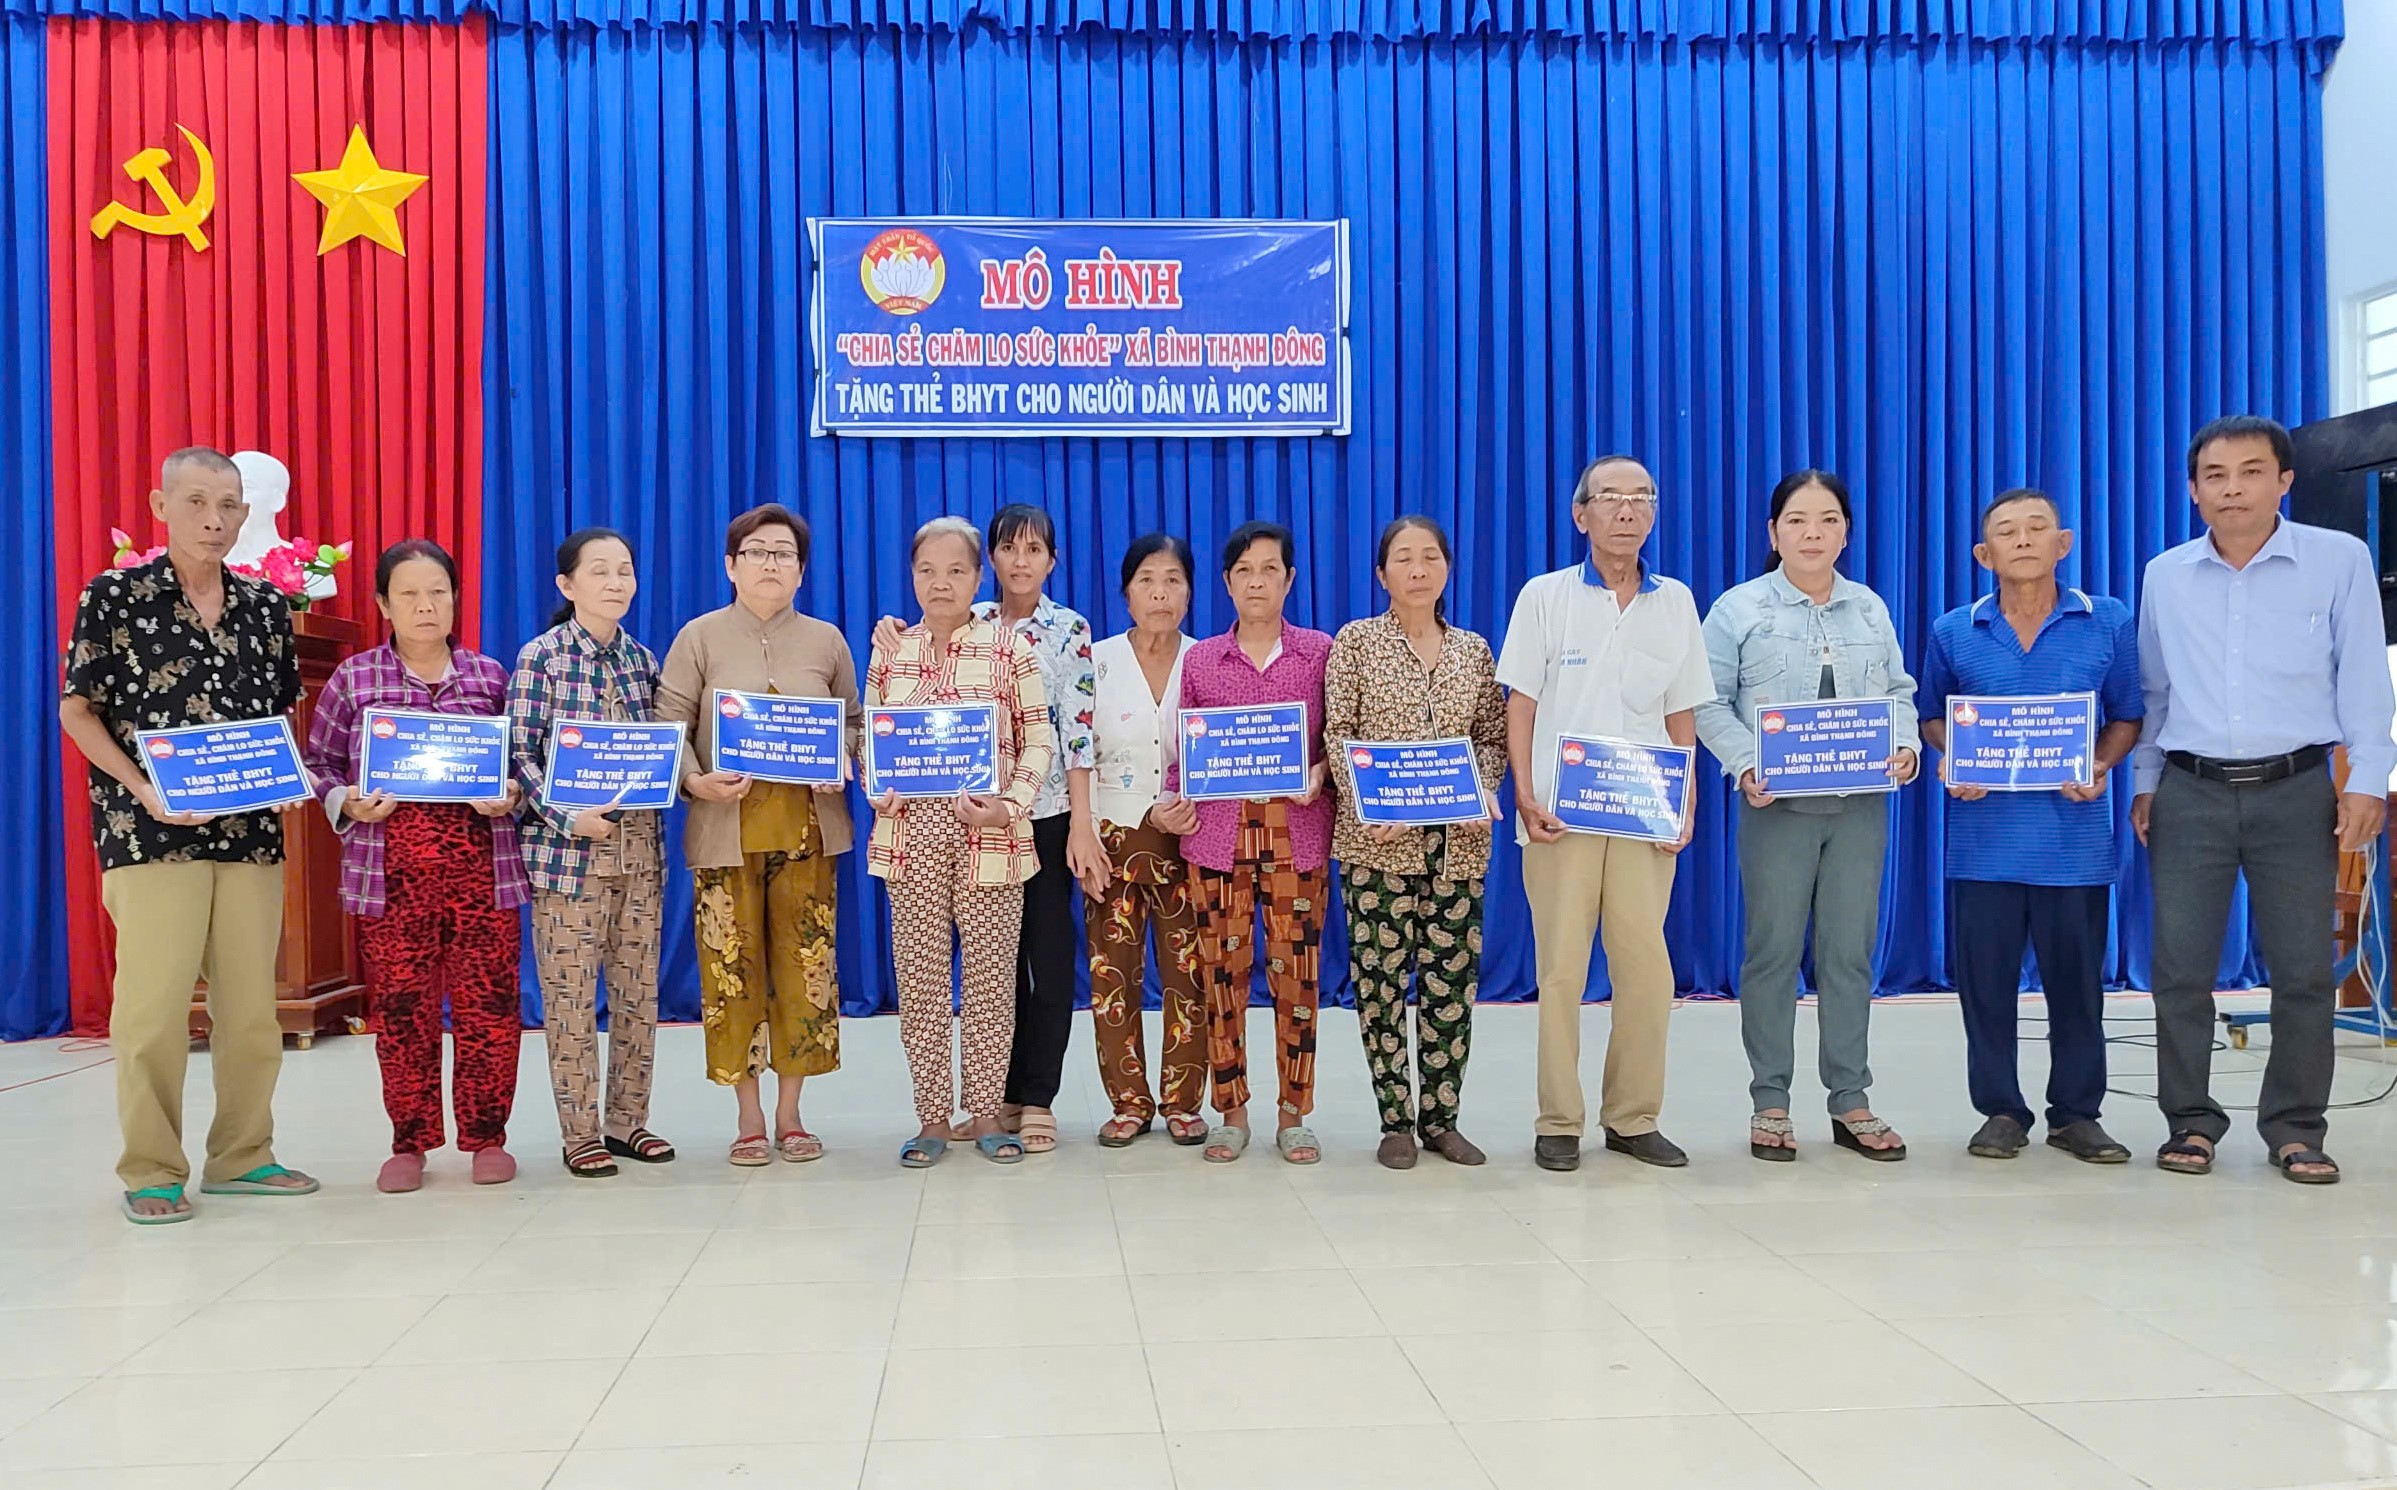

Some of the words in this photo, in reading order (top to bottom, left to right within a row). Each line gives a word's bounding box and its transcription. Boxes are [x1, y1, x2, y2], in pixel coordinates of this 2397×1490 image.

[981, 246, 1052, 310] MÔ
[1065, 246, 1181, 310] HÌNH
[896, 325, 922, 366] SẺ
[927, 327, 981, 366] CHĂM
[987, 335, 1012, 366] LO
[1016, 327, 1056, 367] SỨC
[1124, 327, 1152, 366] XÃ
[1155, 328, 1201, 366] BÌNH
[1206, 335, 1268, 373] THẠNH
[1273, 327, 1326, 367] ĐÔNG
[836, 376, 894, 421] TẶNG
[900, 371, 941, 415] THẺ
[951, 382, 1008, 414] BHYT
[1016, 383, 1062, 415] CHO
[1067, 379, 1133, 415] NGƯỜI
[1143, 376, 1186, 414] DÂN
[1192, 377, 1220, 414] VÀ
[1227, 382, 1273, 421] HỌC
[1278, 382, 1327, 414] SINH
[1817, 709, 1832, 719] MÔ
[1835, 707, 1857, 718] HÌNH
[2012, 706, 2027, 715] MÔ
[2031, 706, 2054, 715] HÌNH
[1236, 715, 1249, 725] MÔ
[1252, 713, 1272, 723] HÌNH
[1209, 729, 1224, 737] CHIA
[1258, 726, 1266, 734] LO
[1787, 724, 1803, 732] CHIA
[1784, 753, 1812, 765] TẶNG
[1815, 749, 1836, 762] THẺ
[1840, 750, 1867, 761] BHYT
[2034, 748, 2063, 757] BHYT
[1207, 757, 1232, 769] TẶNG
[1234, 753, 1253, 766] THẺ
[1257, 755, 1281, 765] BHYT
[1956, 760, 1974, 768] CHO
[2027, 759, 2039, 768] VÀ
[2042, 760, 2060, 769] HỌC
[1190, 771, 1205, 779] CHO
[1233, 768, 1249, 777] DÂN
[1251, 767, 1262, 776] VÀ
[1264, 767, 1280, 776] HỌC
[1282, 766, 1300, 774] SINH
[1765, 767, 1782, 776] CHO
[1813, 763, 1831, 773] DÂN
[1834, 763, 1845, 772] VÀ
[1848, 762, 1865, 772] HỌC
